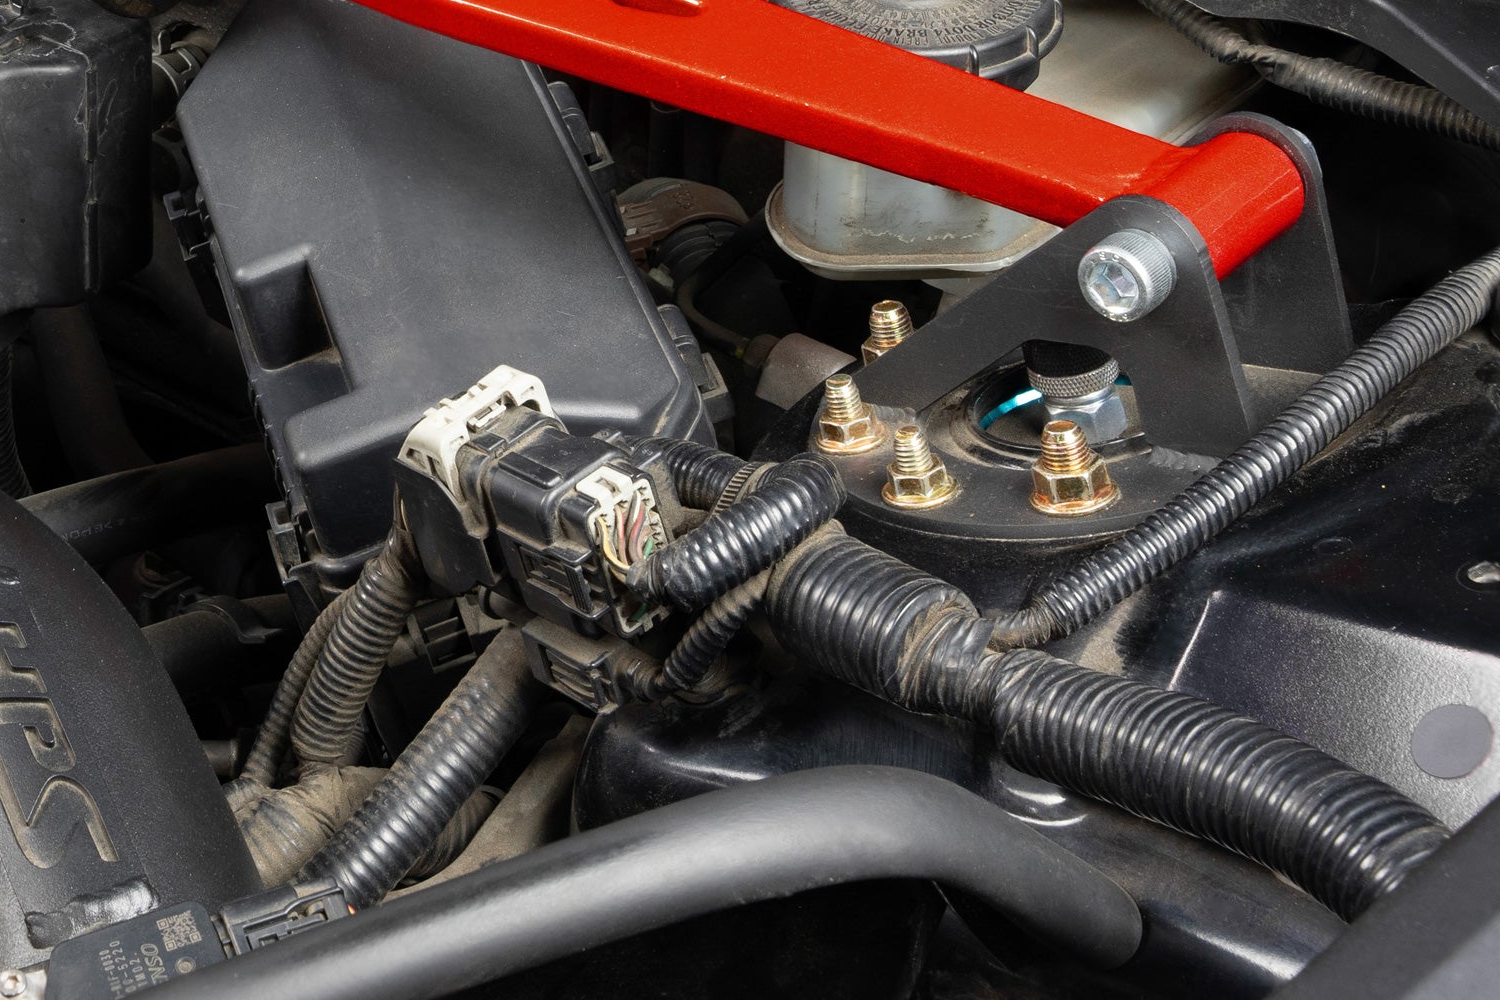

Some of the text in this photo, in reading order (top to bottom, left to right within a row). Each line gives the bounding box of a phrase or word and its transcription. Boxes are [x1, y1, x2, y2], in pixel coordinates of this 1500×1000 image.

[824, 10, 868, 31] FLUID
[974, 18, 998, 29] OR
[873, 25, 928, 38] BRAKE
[934, 24, 976, 37] DOT4
